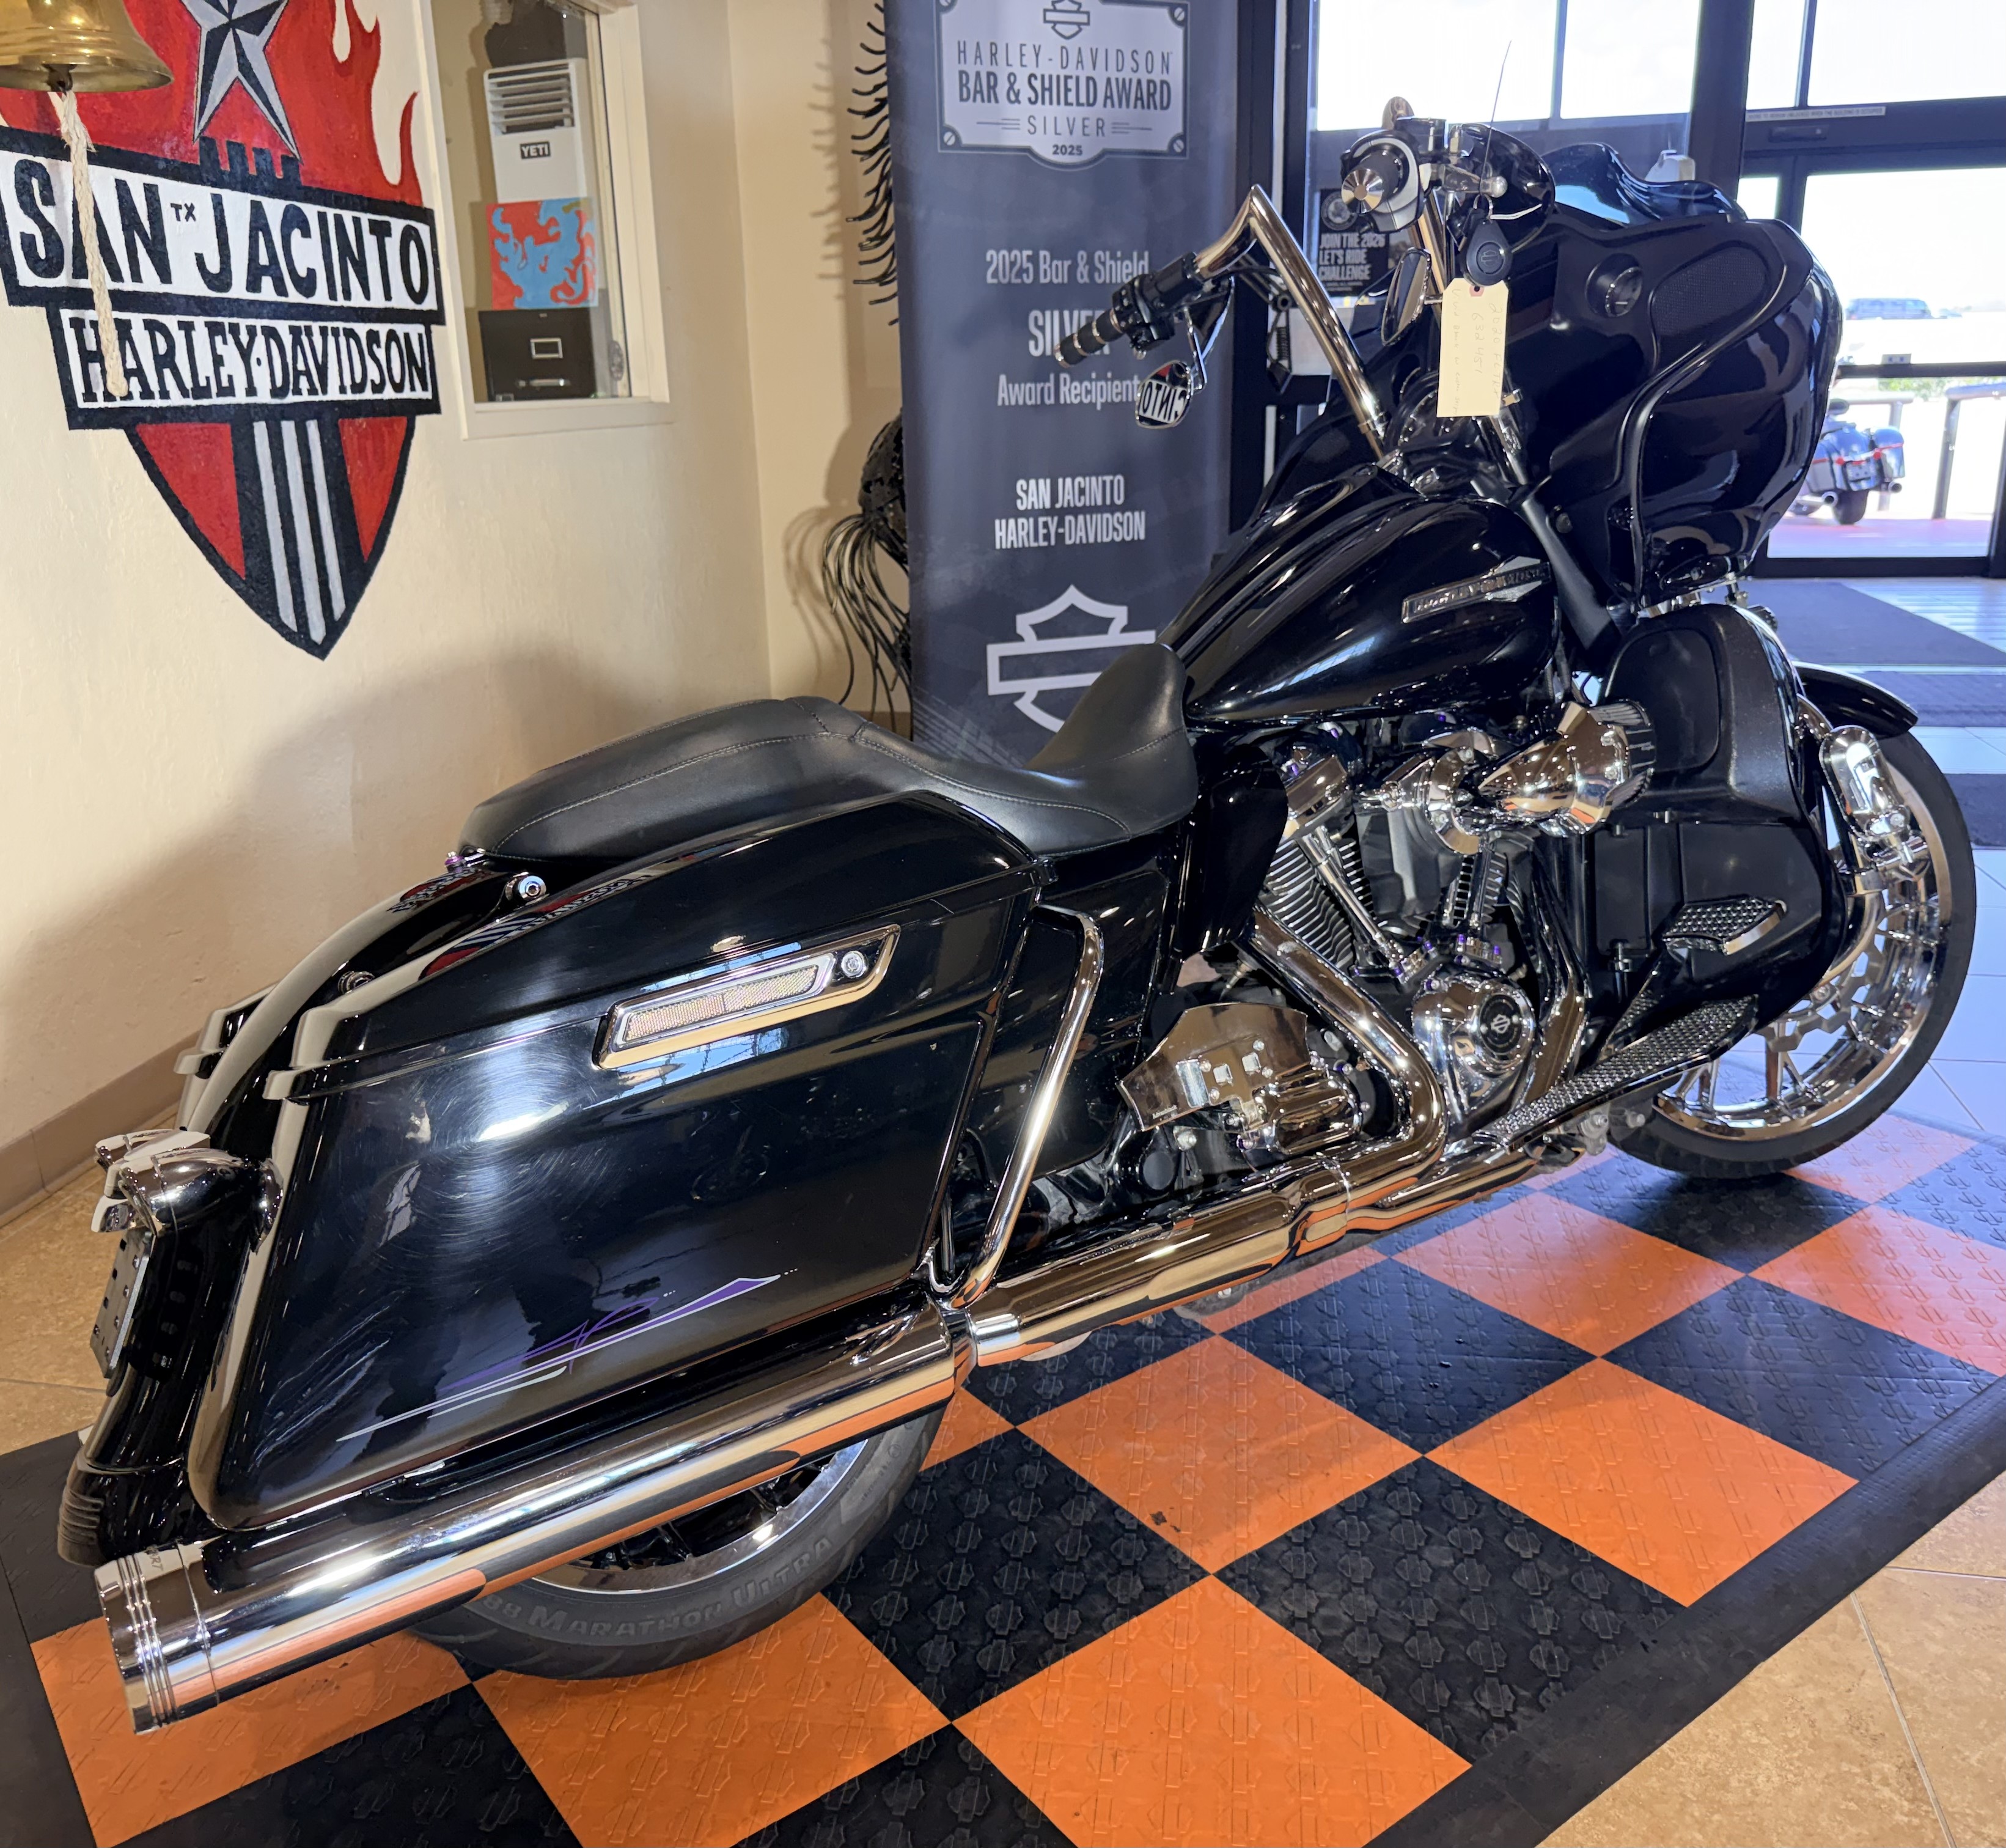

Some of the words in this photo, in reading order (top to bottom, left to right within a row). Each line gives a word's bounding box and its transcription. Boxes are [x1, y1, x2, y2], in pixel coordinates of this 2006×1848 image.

[957, 40, 1170, 75] HARLEY-DAVIDSON
[958, 70, 999, 103] BAR
[1006, 72, 1021, 105] &
[1027, 73, 1098, 107] SHIELD
[1103, 77, 1171, 111] AWARD
[1027, 115, 1105, 137] SILVER
[521, 144, 548, 157] YETI
[1052, 144, 1082, 156] 2025
[15, 159, 172, 284] SAN
[171, 202, 196, 222] TX
[194, 193, 428, 304] JACINTO
[1320, 233, 1342, 248] JOIN
[1342, 233, 1359, 248] THE
[985, 249, 1034, 284] 2025
[1039, 250, 1071, 284] Bar
[1076, 250, 1090, 284] &
[1318, 265, 1370, 281] CHALLENGE
[1345, 249, 1367, 265] RIDE
[997, 373, 1054, 406] Award
[1059, 371, 1141, 410] Recipient
[1016, 478, 1051, 511] SAN
[1054, 474, 1125, 509] JACINTO
[994, 510, 1145, 550] HARLEY-DAVIDSON
